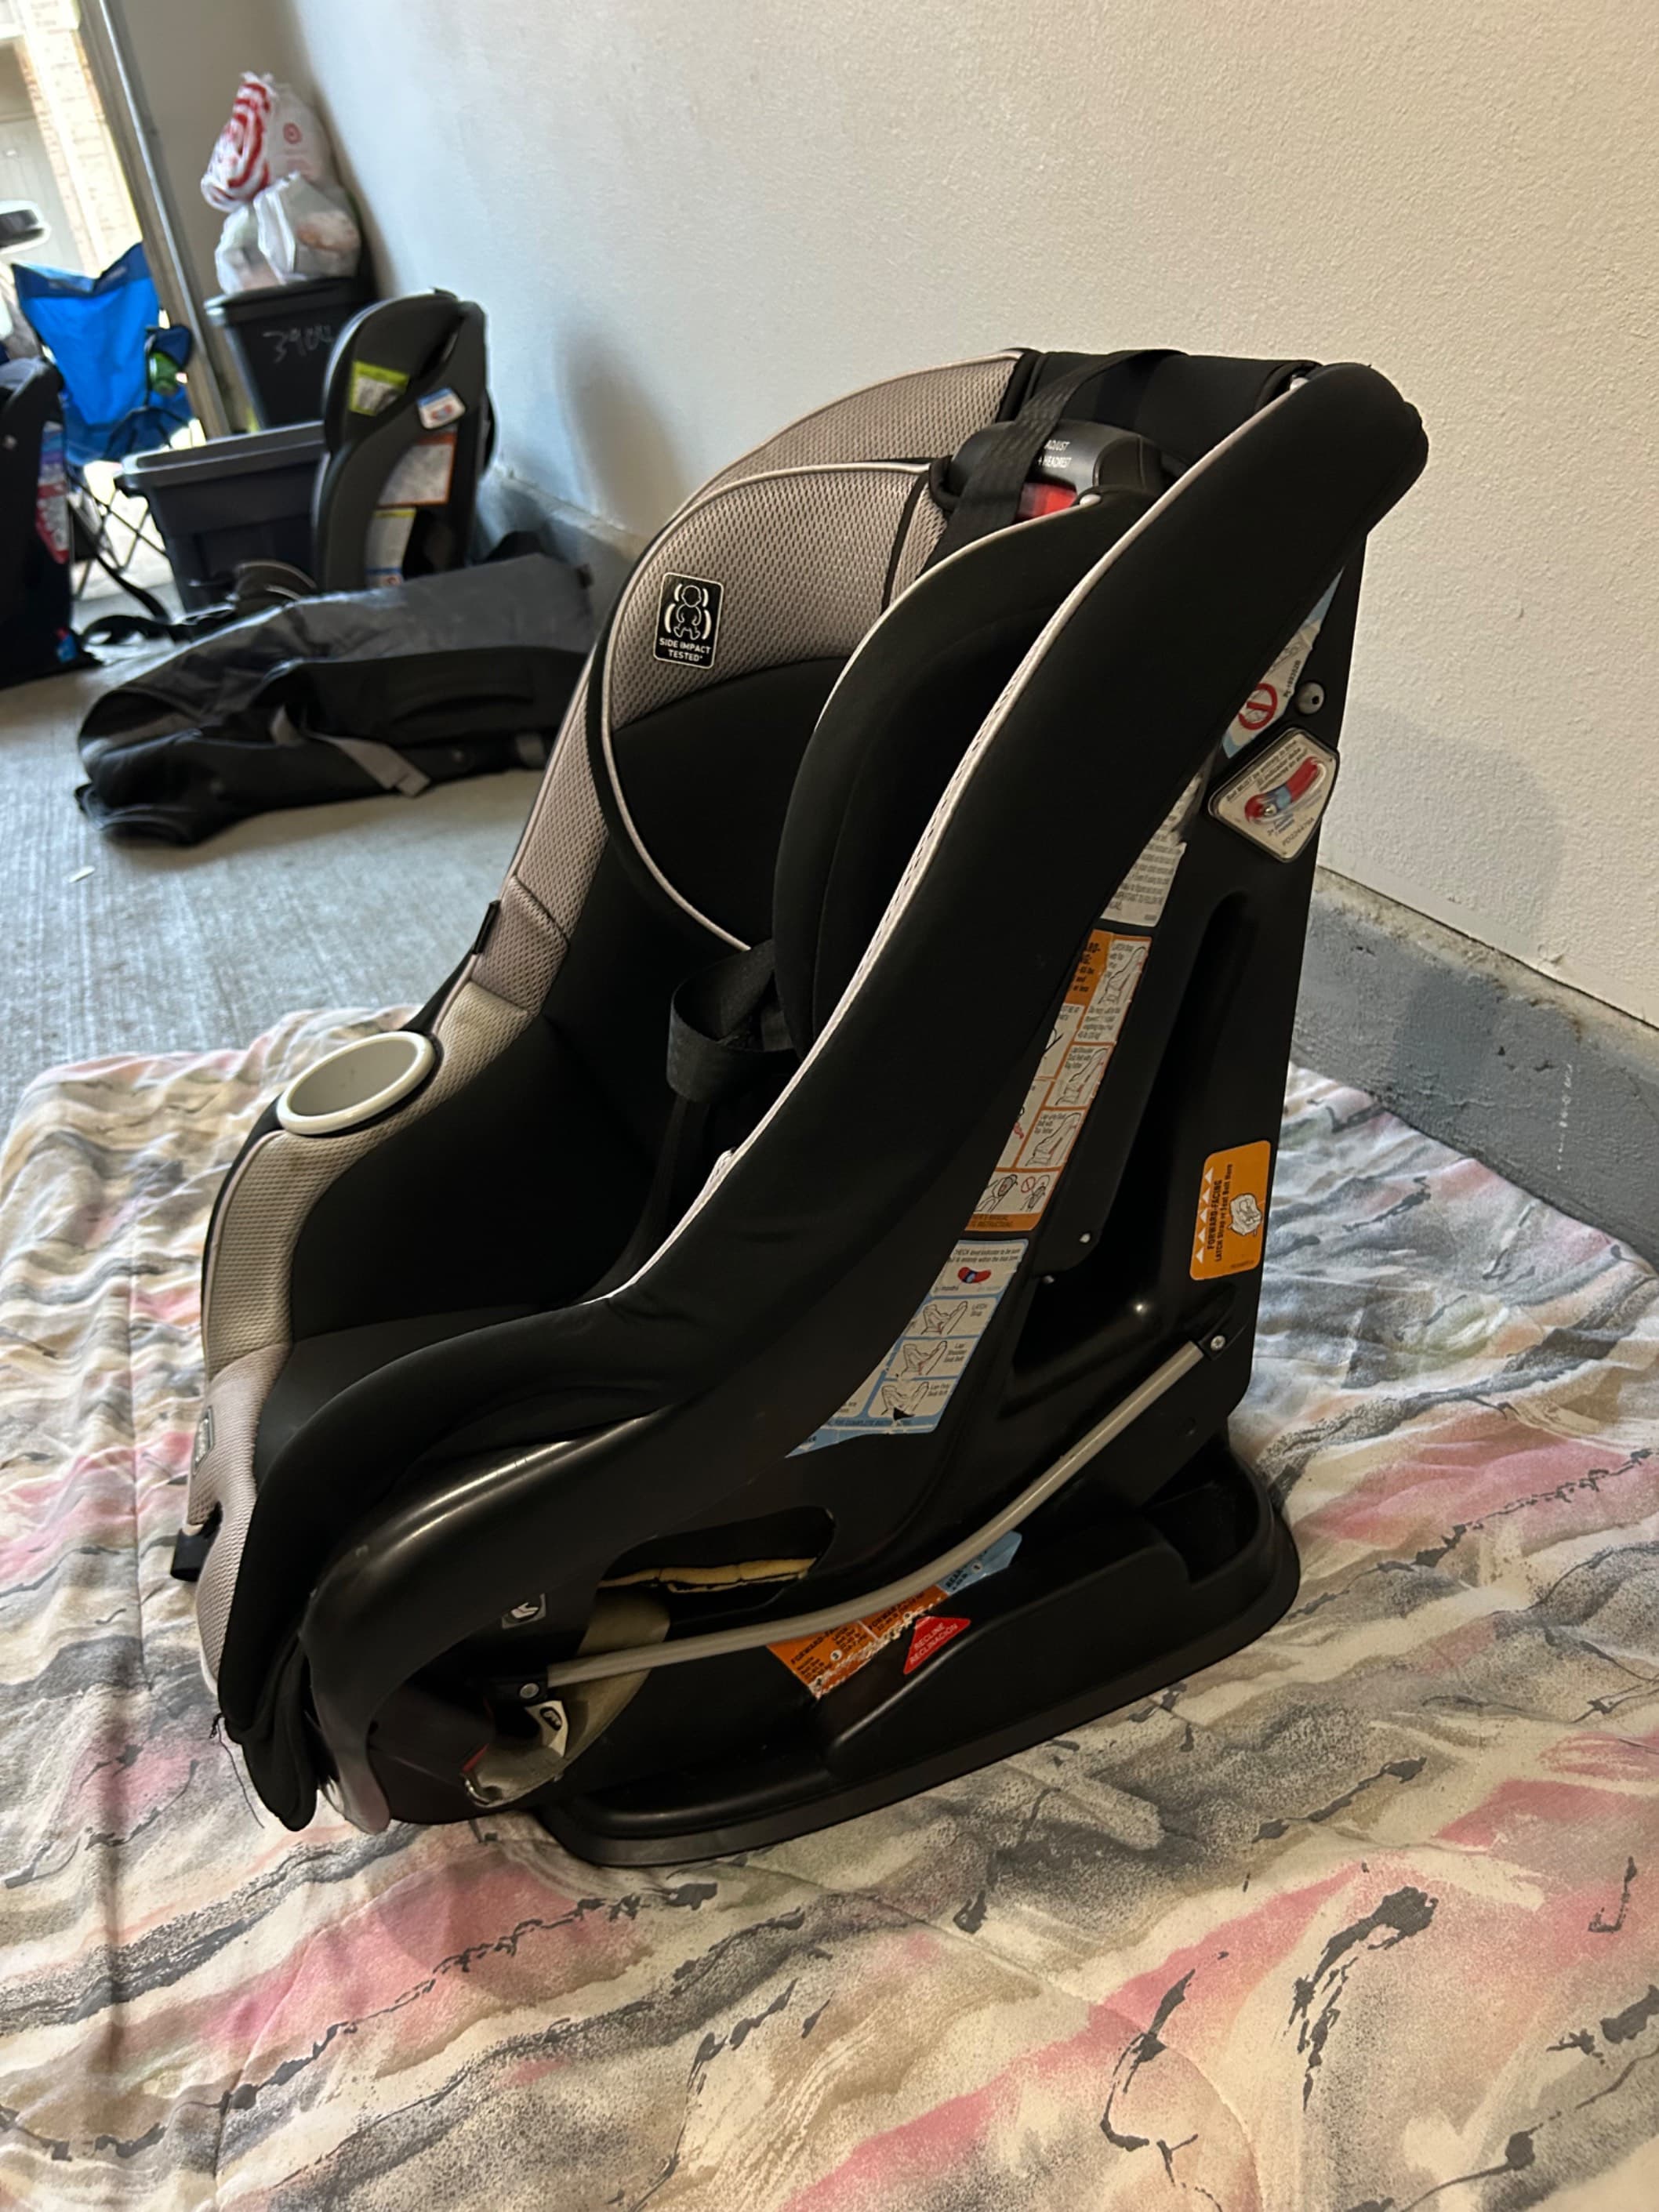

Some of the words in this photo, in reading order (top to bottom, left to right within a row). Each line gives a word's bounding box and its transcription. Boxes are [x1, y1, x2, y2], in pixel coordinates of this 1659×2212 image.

[659, 637, 678, 649] SIDE
[680, 641, 711, 654] IMPACT
[1207, 1180, 1222, 1249] FORWARD-FACING
[913, 1622, 946, 1651] RECLINE
